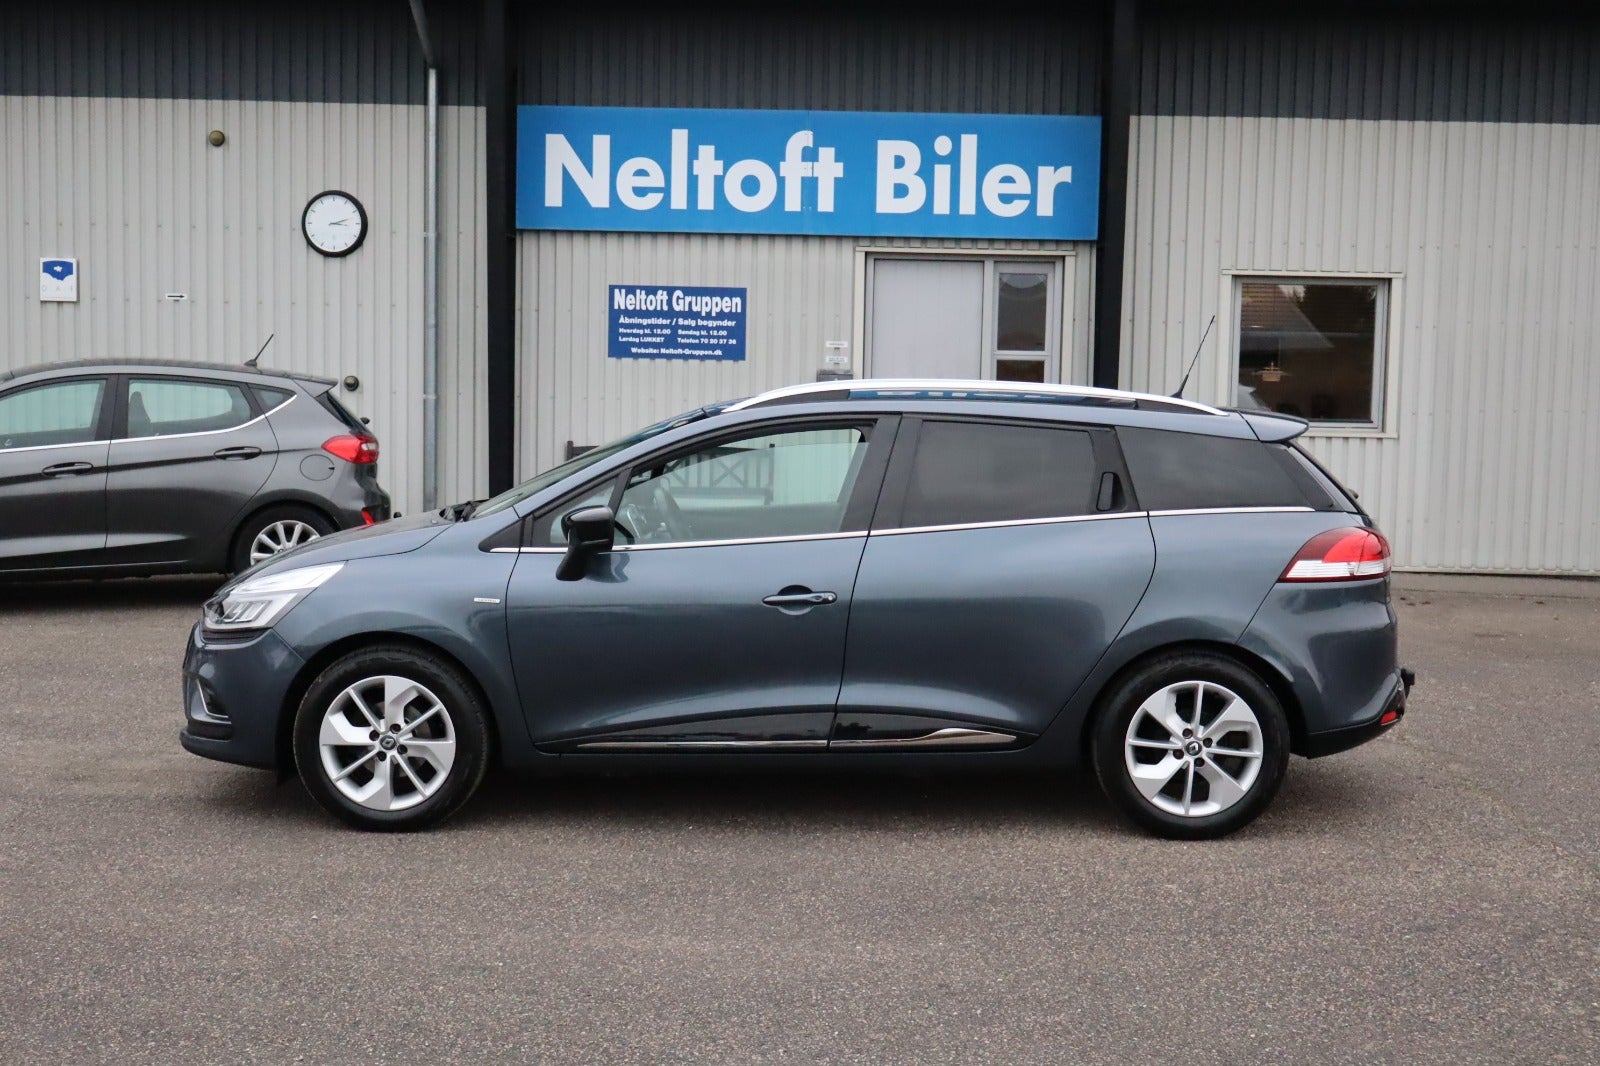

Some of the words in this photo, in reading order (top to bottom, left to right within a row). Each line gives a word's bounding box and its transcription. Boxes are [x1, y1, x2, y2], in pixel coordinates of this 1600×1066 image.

[545, 128, 843, 212] Neltoft
[876, 134, 1072, 217] Biler
[614, 289, 668, 311] Neltoft
[672, 290, 742, 316] Gruppen
[619, 315, 671, 325] Åbningstider
[678, 318, 696, 326] Salg
[698, 318, 736, 327] begynder
